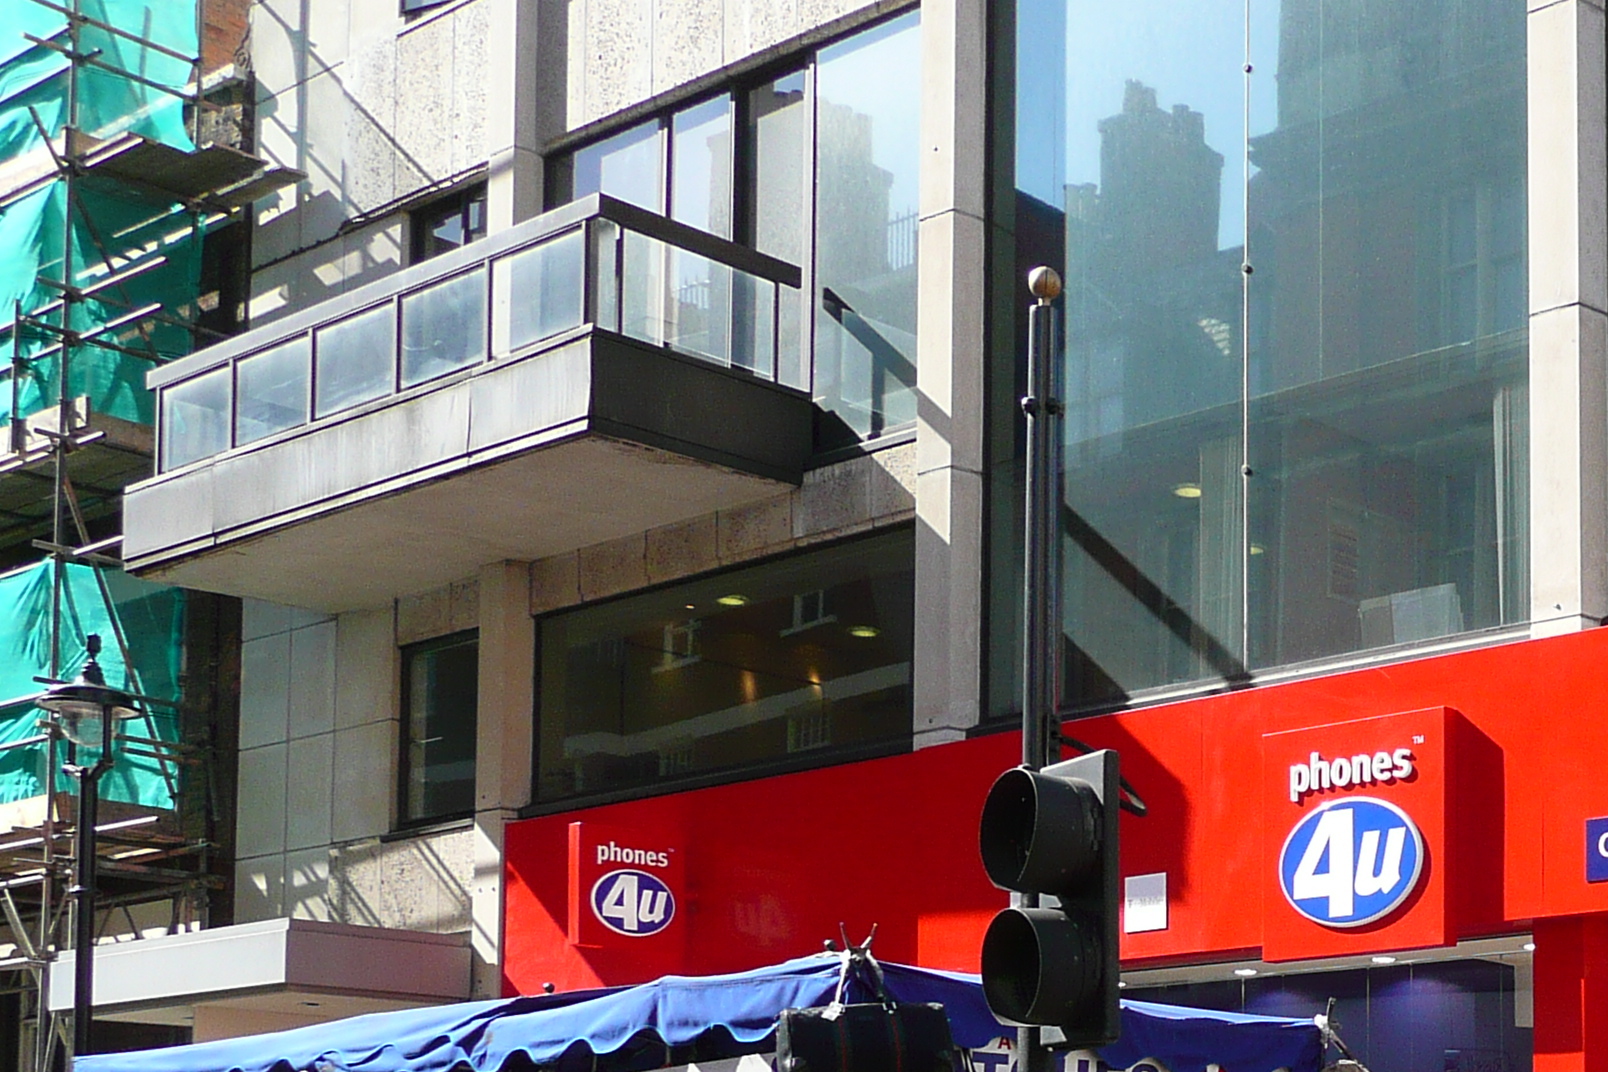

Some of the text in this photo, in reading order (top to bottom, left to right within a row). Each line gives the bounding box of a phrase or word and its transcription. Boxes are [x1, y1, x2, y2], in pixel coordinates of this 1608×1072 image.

[1290, 748, 1412, 802] phones
[596, 840, 669, 868] phones
[1293, 807, 1406, 918] 4u
[602, 874, 668, 931] 4u
